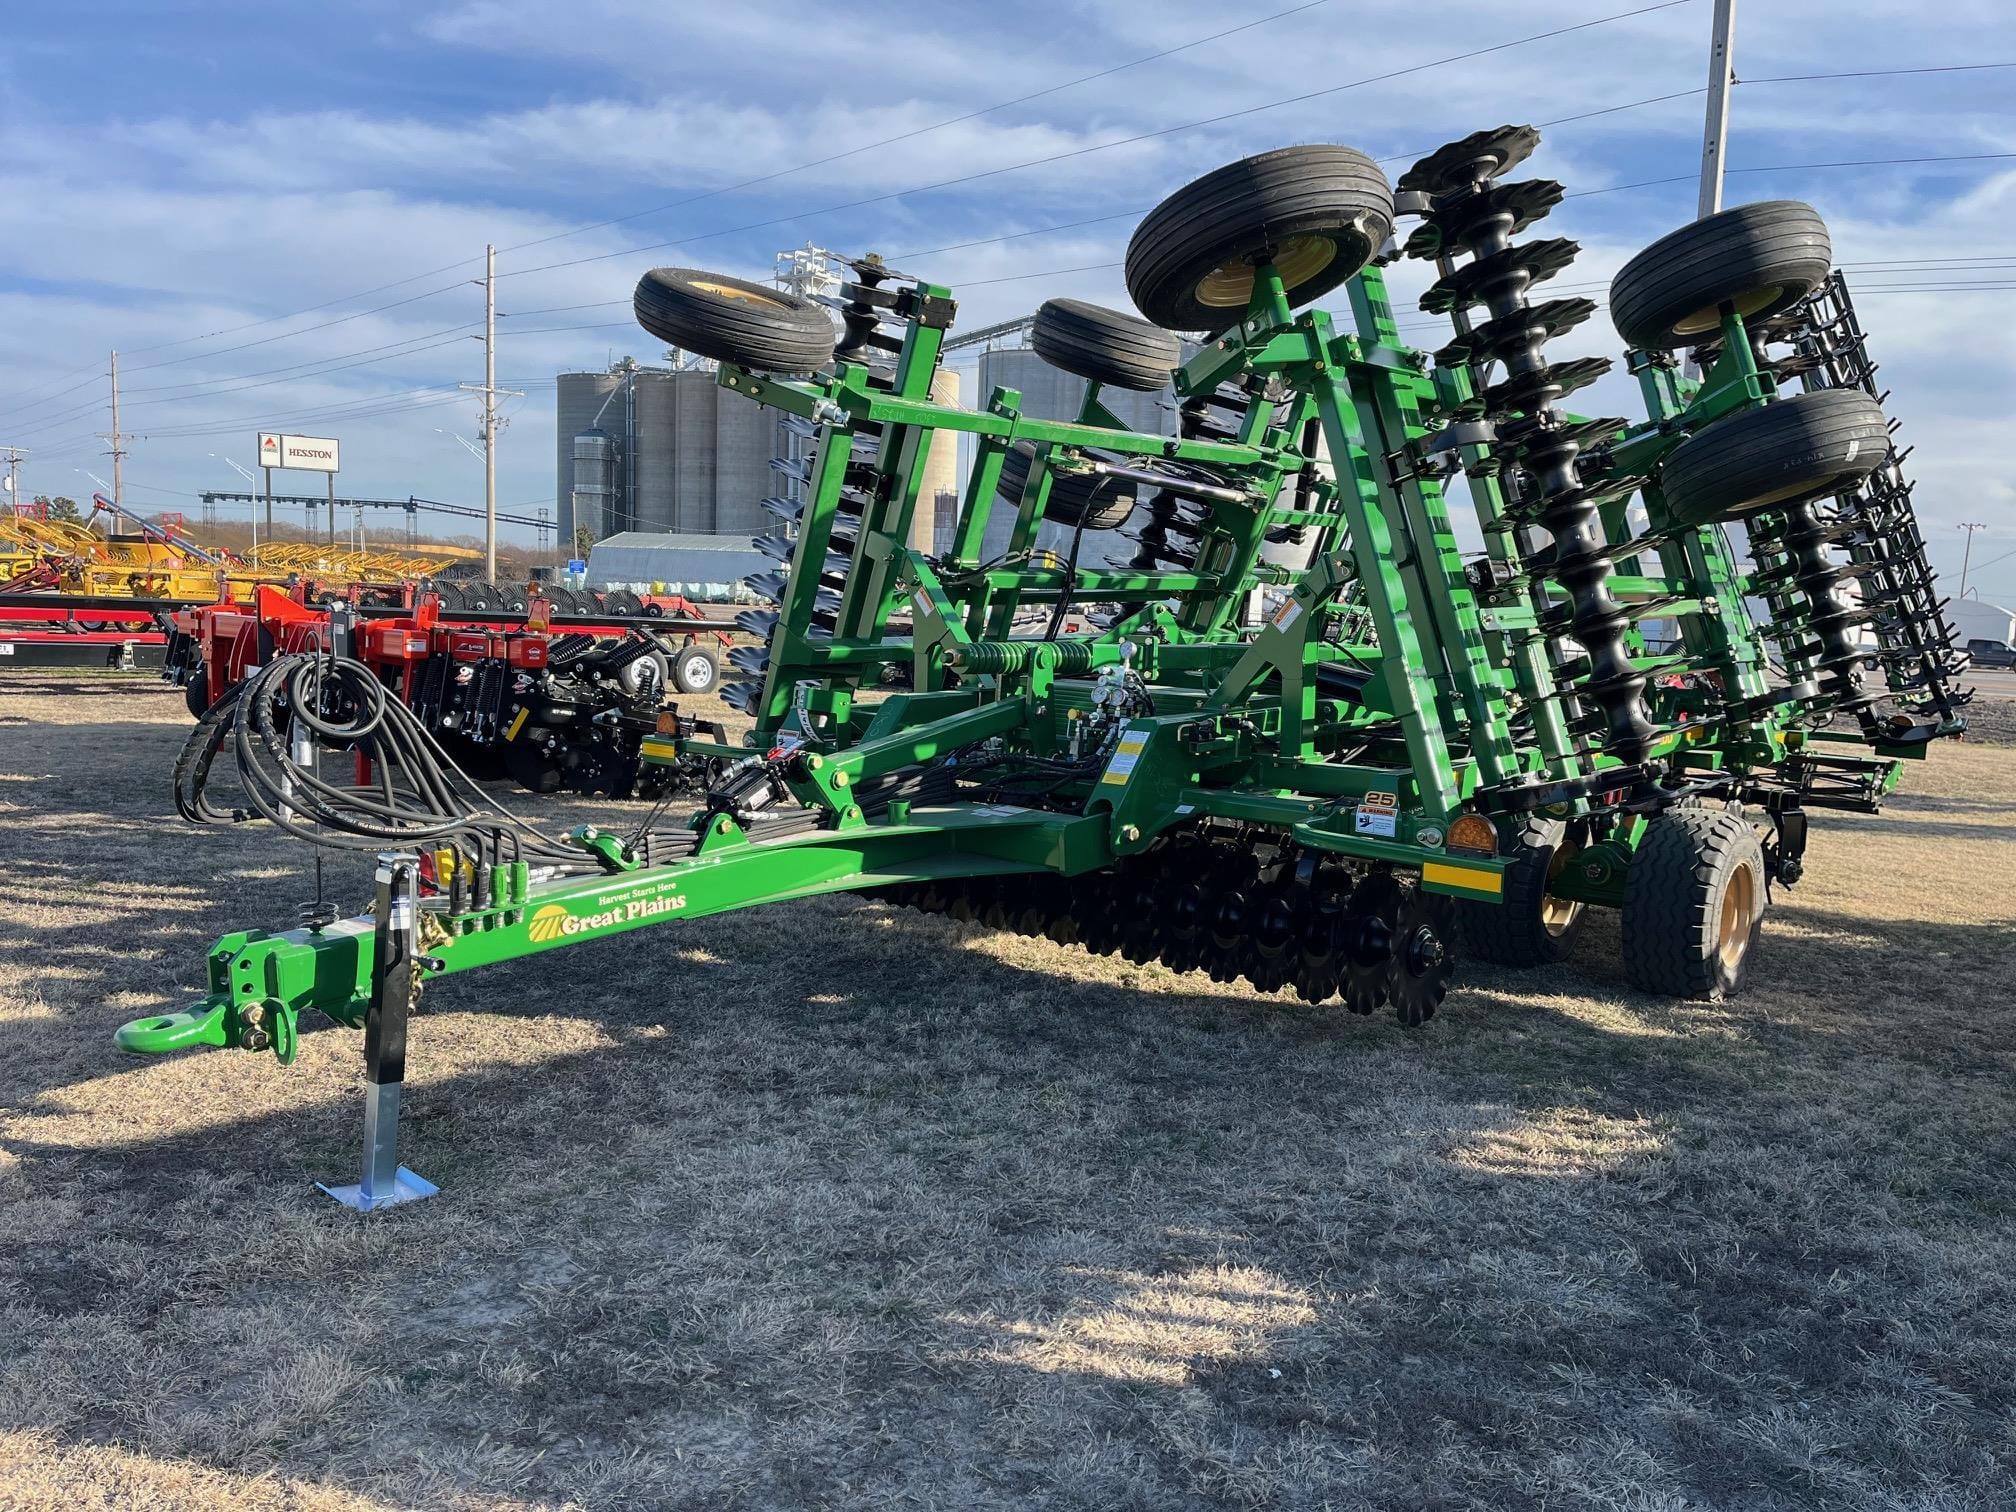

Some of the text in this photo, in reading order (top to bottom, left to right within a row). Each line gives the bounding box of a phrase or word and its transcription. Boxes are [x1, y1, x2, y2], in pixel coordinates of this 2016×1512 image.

[289, 448, 332, 459] HESSTON
[1366, 792, 1395, 807] 25
[598, 882, 677, 905] Harvest Starts Here
[561, 894, 687, 935] Great Plains
